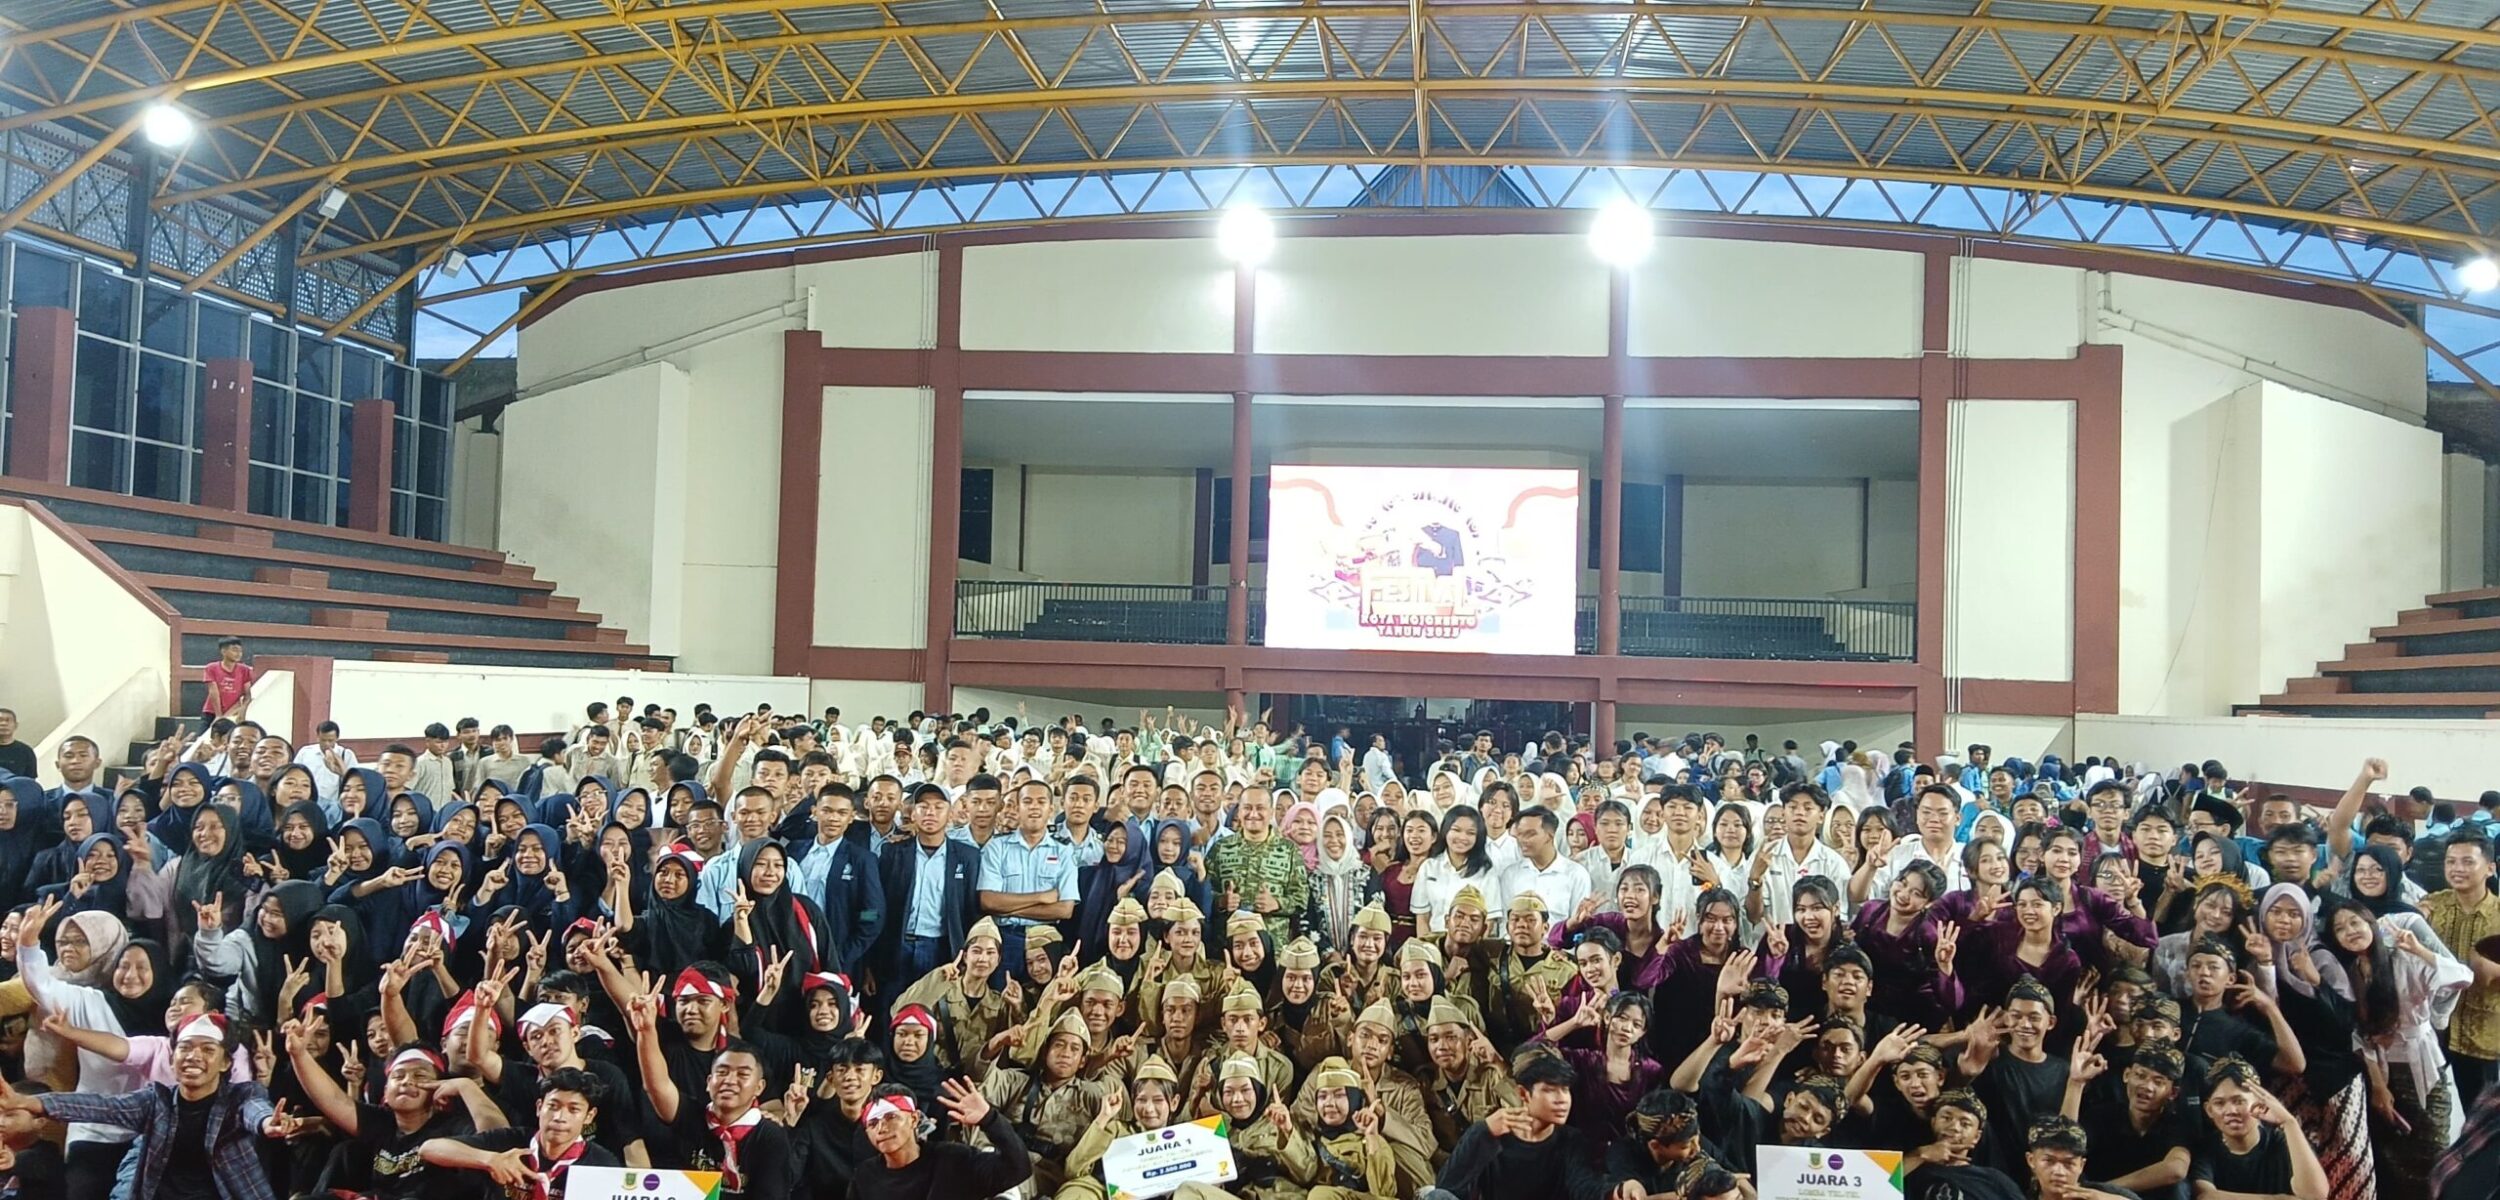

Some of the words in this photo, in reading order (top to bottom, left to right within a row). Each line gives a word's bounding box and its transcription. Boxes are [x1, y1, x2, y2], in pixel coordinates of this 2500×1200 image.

[1361, 614, 1395, 625] KOTA
[1377, 626, 1422, 637] TAHUN
[1137, 1142, 1182, 1156] JUARA
[1186, 1138, 1193, 1146] 1
[1796, 1173, 1849, 1187] JUARA
[1853, 1176, 1863, 1187] 3
